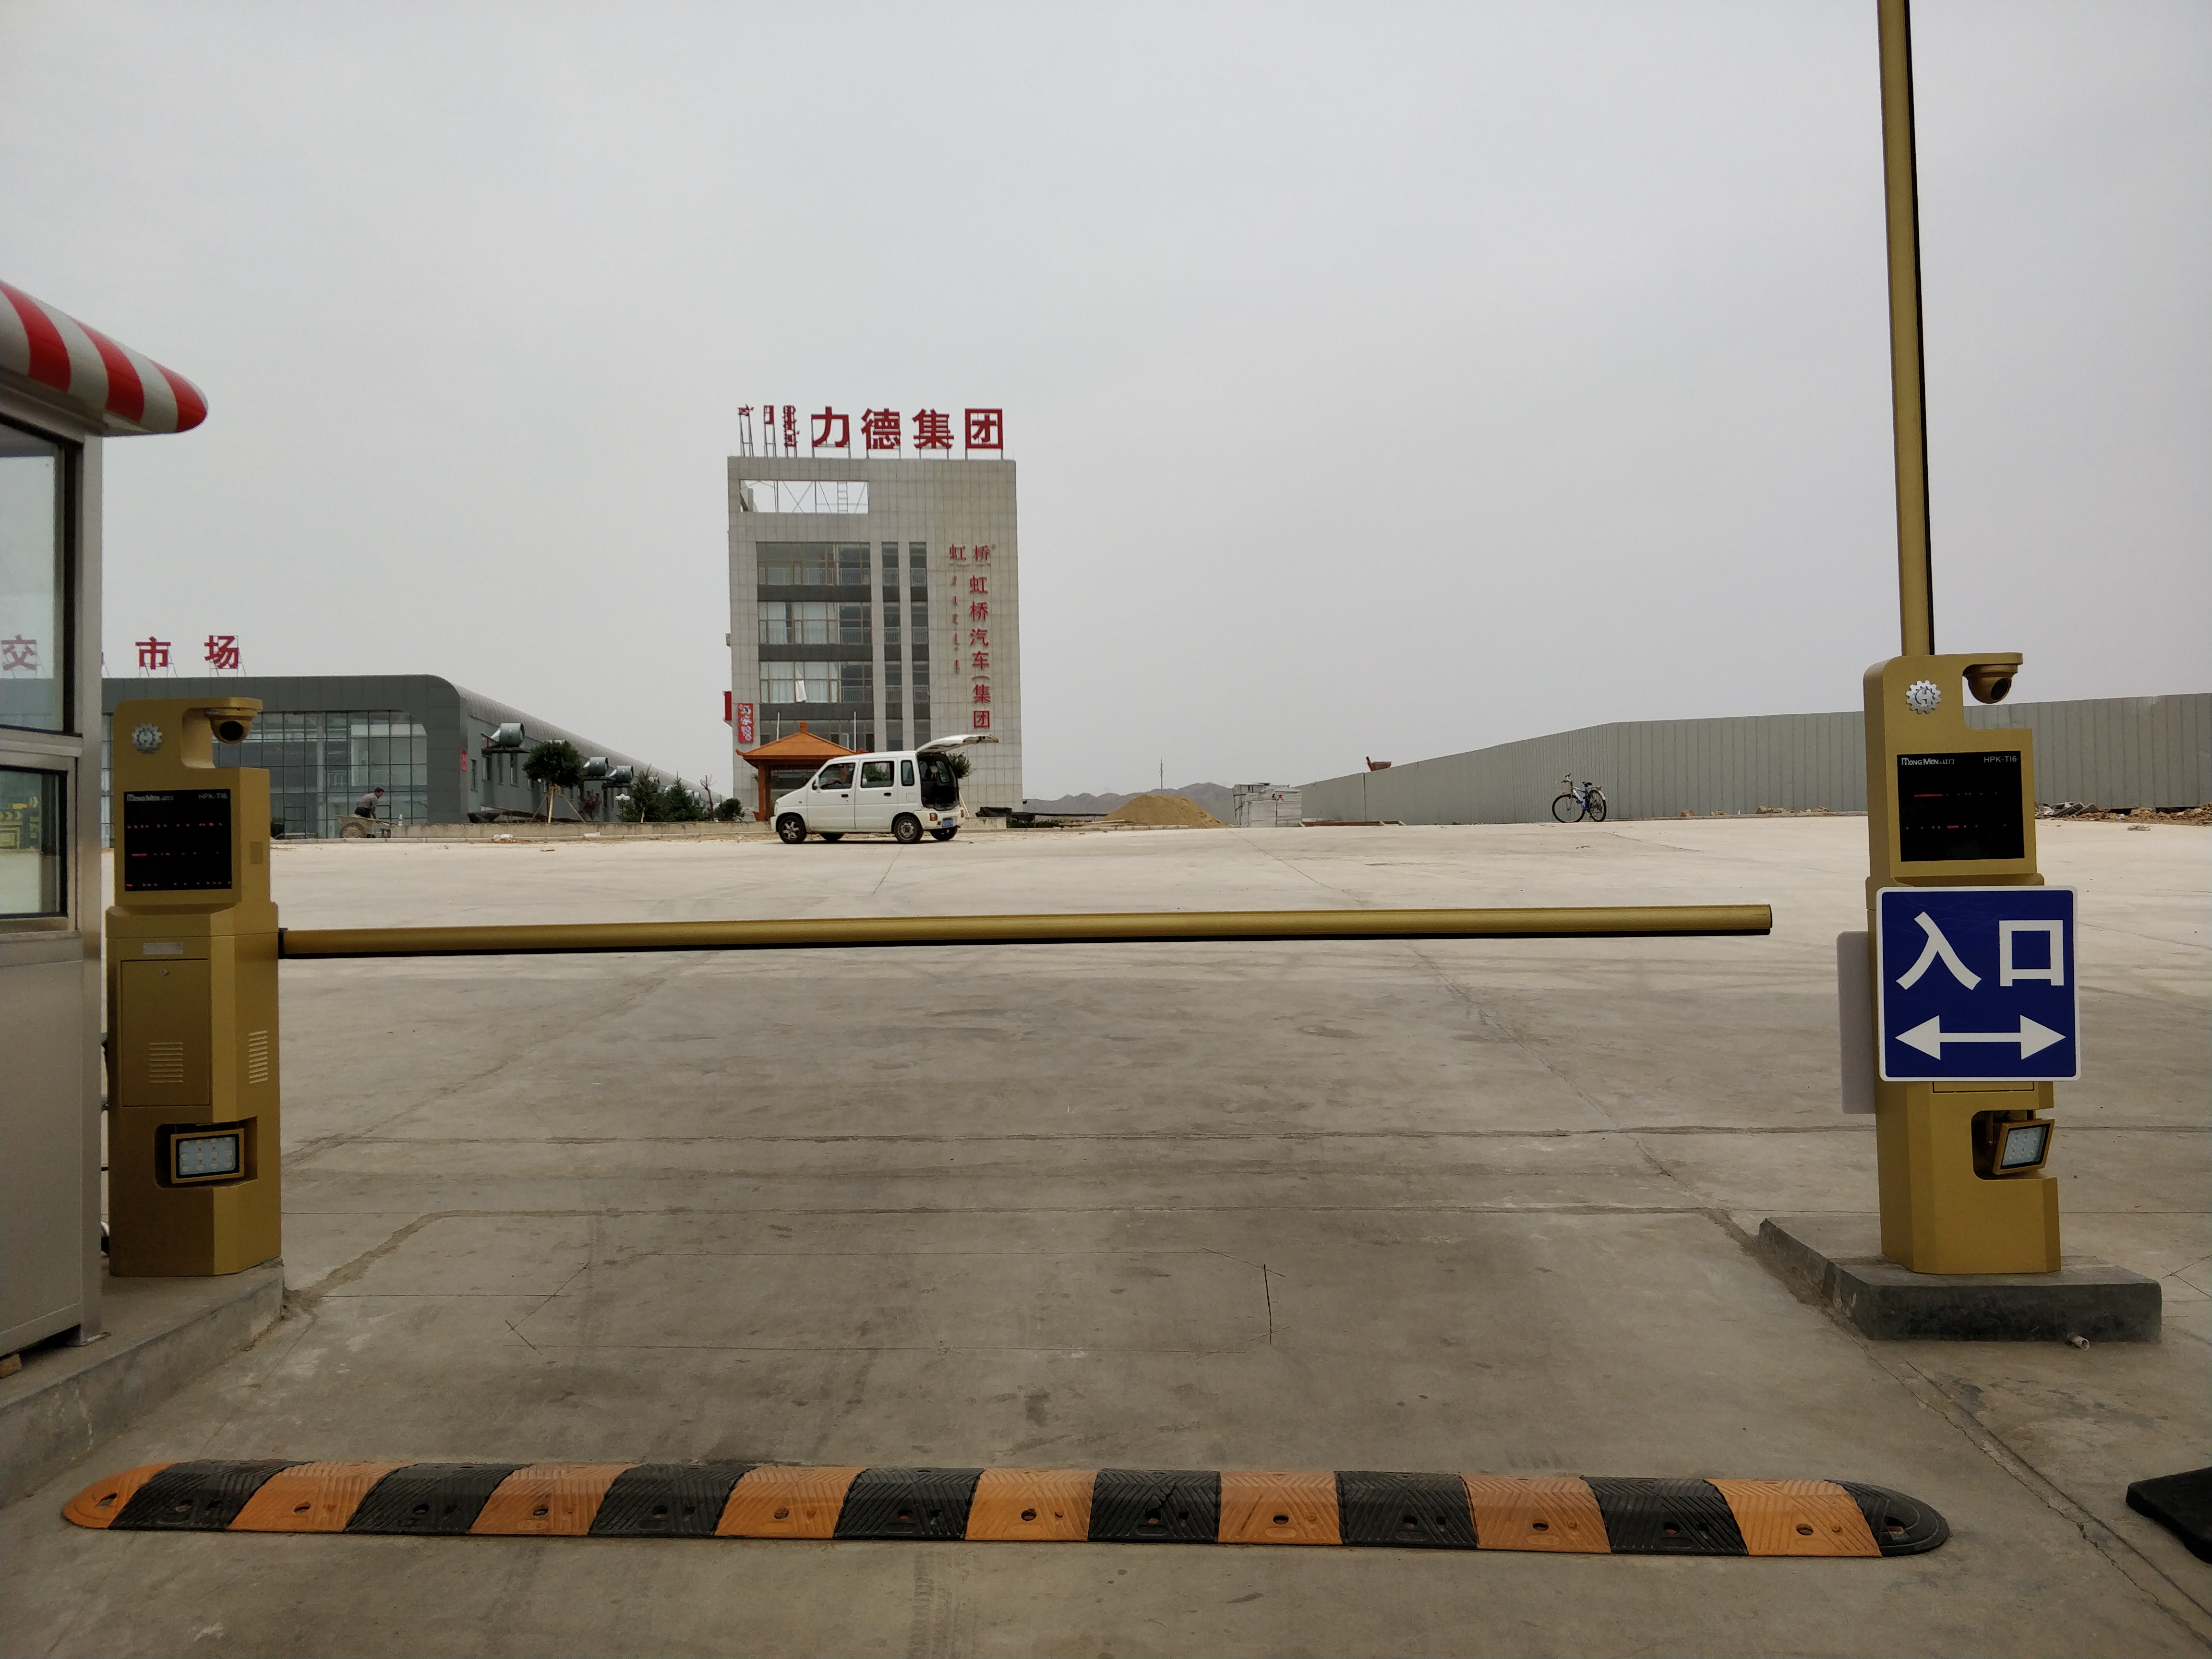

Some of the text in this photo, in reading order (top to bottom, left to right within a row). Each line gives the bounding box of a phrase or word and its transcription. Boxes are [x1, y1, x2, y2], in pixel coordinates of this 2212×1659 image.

[811, 406, 1004, 450] 力德集团
[949, 543, 990, 562] 虹桥
[1896, 911, 2064, 990] 入口
